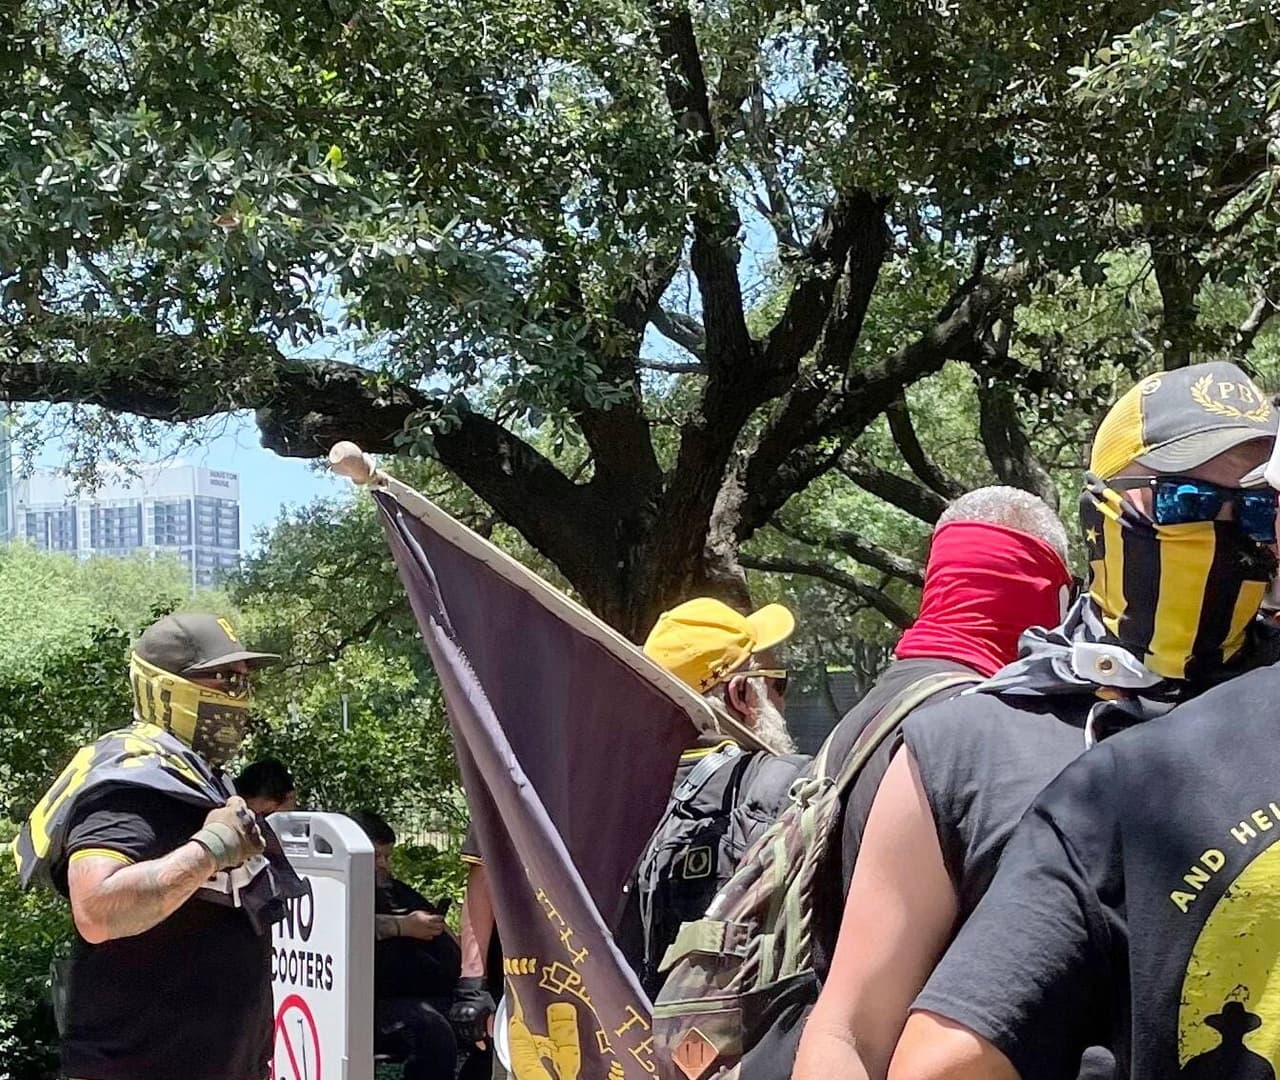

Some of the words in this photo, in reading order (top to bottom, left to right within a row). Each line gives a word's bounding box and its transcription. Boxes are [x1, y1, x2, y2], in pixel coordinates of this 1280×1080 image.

[279, 876, 314, 942] NO
[1169, 848, 1226, 913] AND
[271, 946, 333, 991] COOTERS
